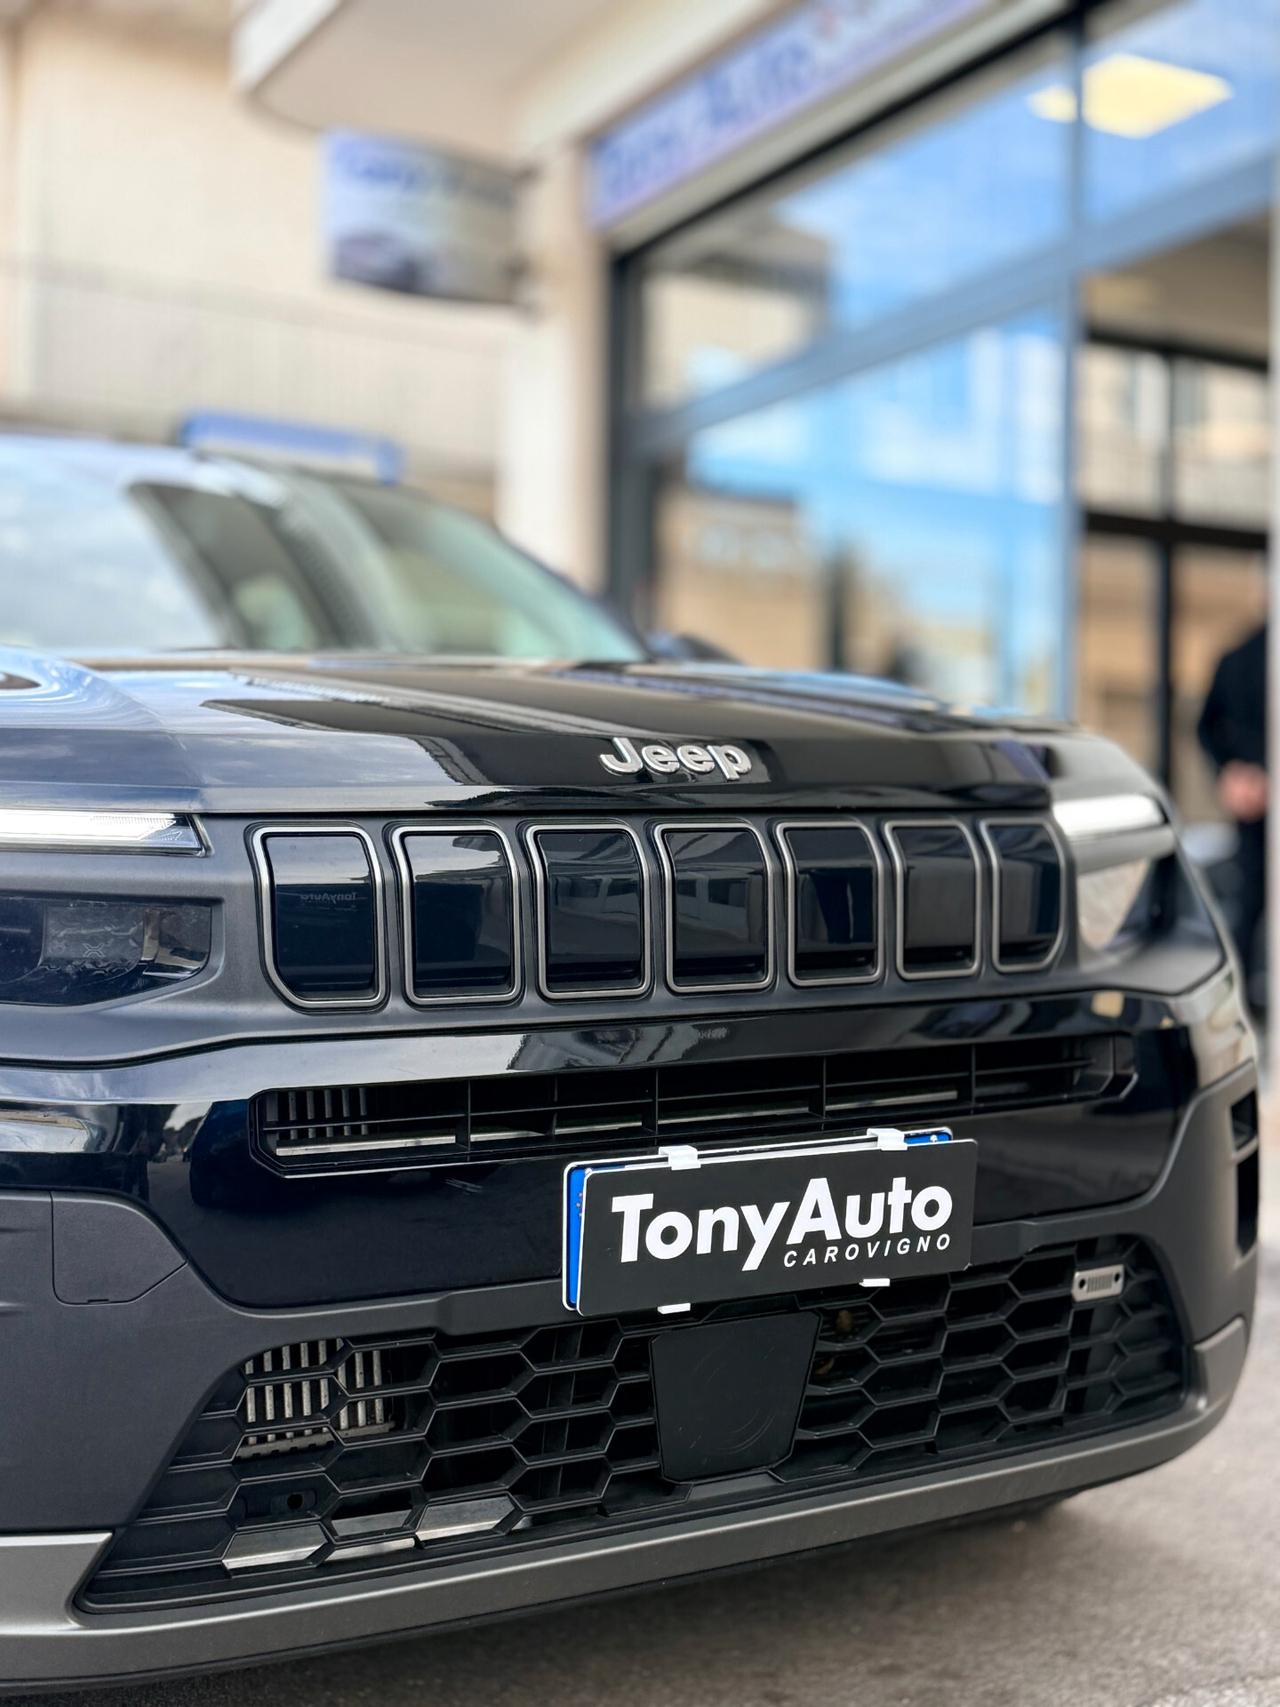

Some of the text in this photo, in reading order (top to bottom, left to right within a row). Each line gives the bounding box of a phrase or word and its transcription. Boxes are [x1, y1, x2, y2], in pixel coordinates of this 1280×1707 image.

[600, 737, 752, 780] Jeep
[611, 1176, 953, 1271] TonyAuto
[783, 1233, 951, 1268] CAROVIGNO
